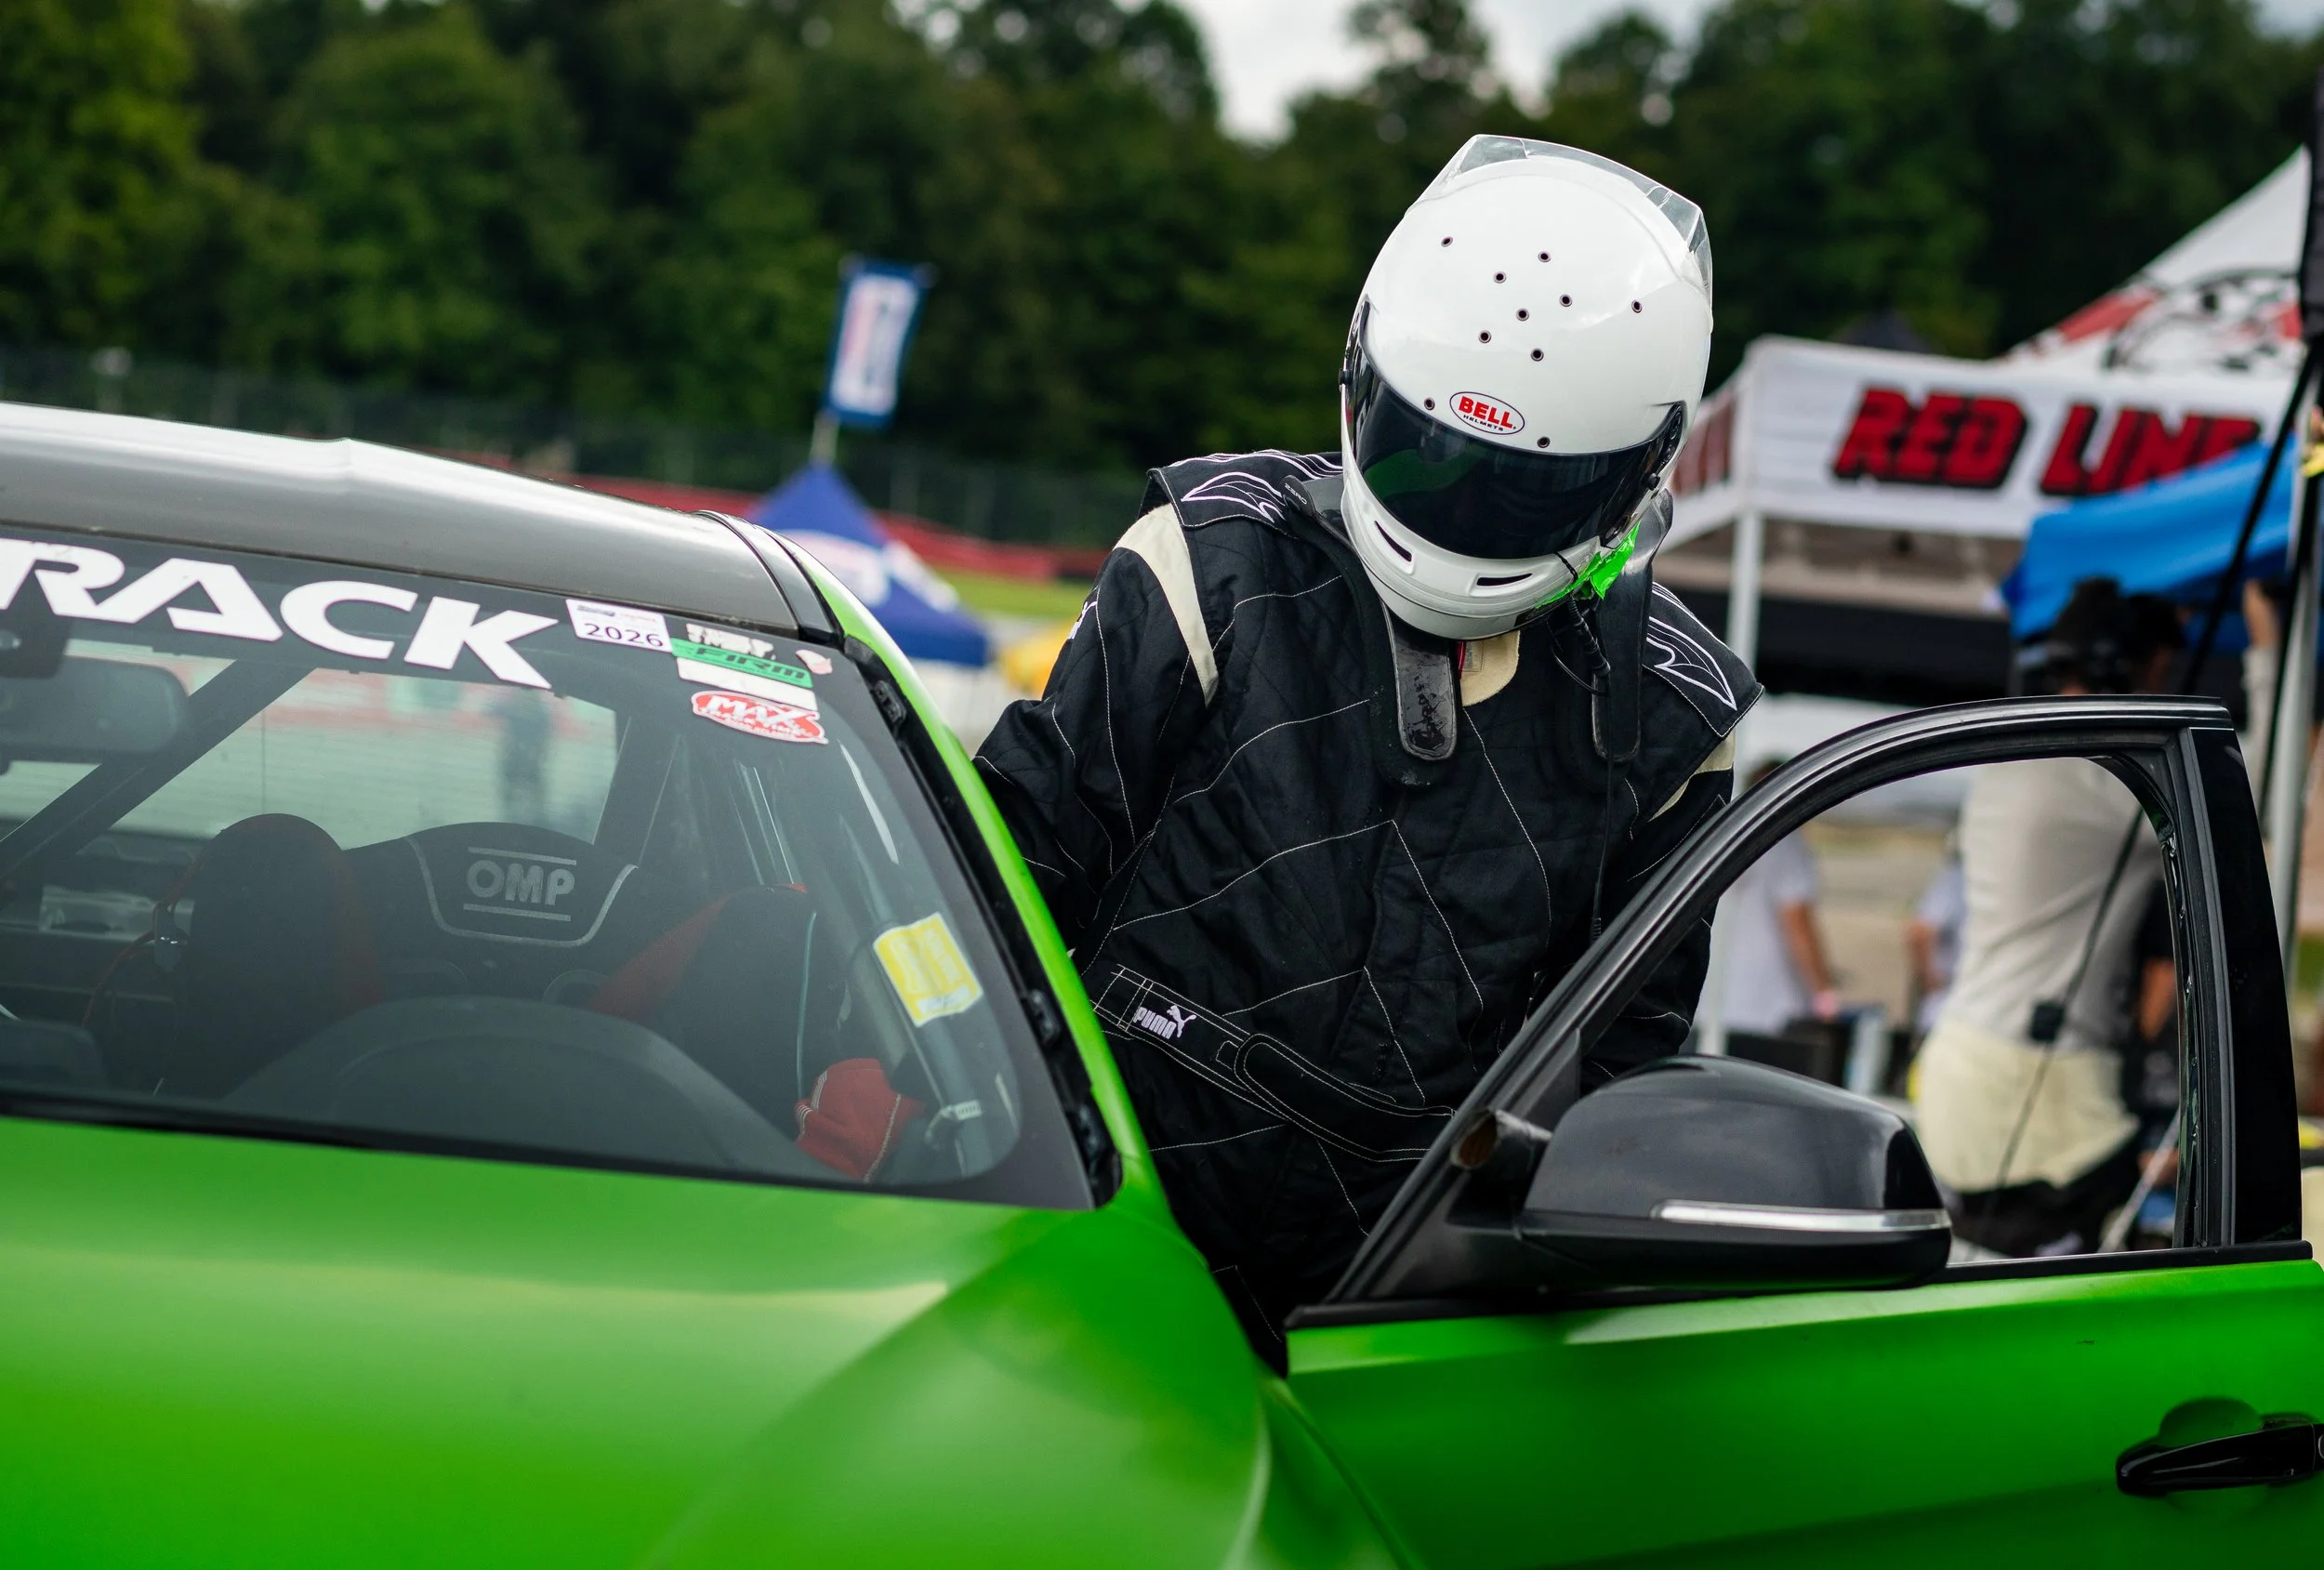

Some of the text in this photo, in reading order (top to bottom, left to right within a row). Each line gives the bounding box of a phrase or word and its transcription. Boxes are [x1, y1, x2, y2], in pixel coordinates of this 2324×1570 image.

[1459, 396, 1512, 429] BELL
[1463, 415, 1503, 431] HELMETS
[1830, 385, 2028, 489] RED
[584, 623, 664, 647] 2026
[467, 860, 575, 905] OMP
[1132, 1007, 1177, 1039] PUMA
